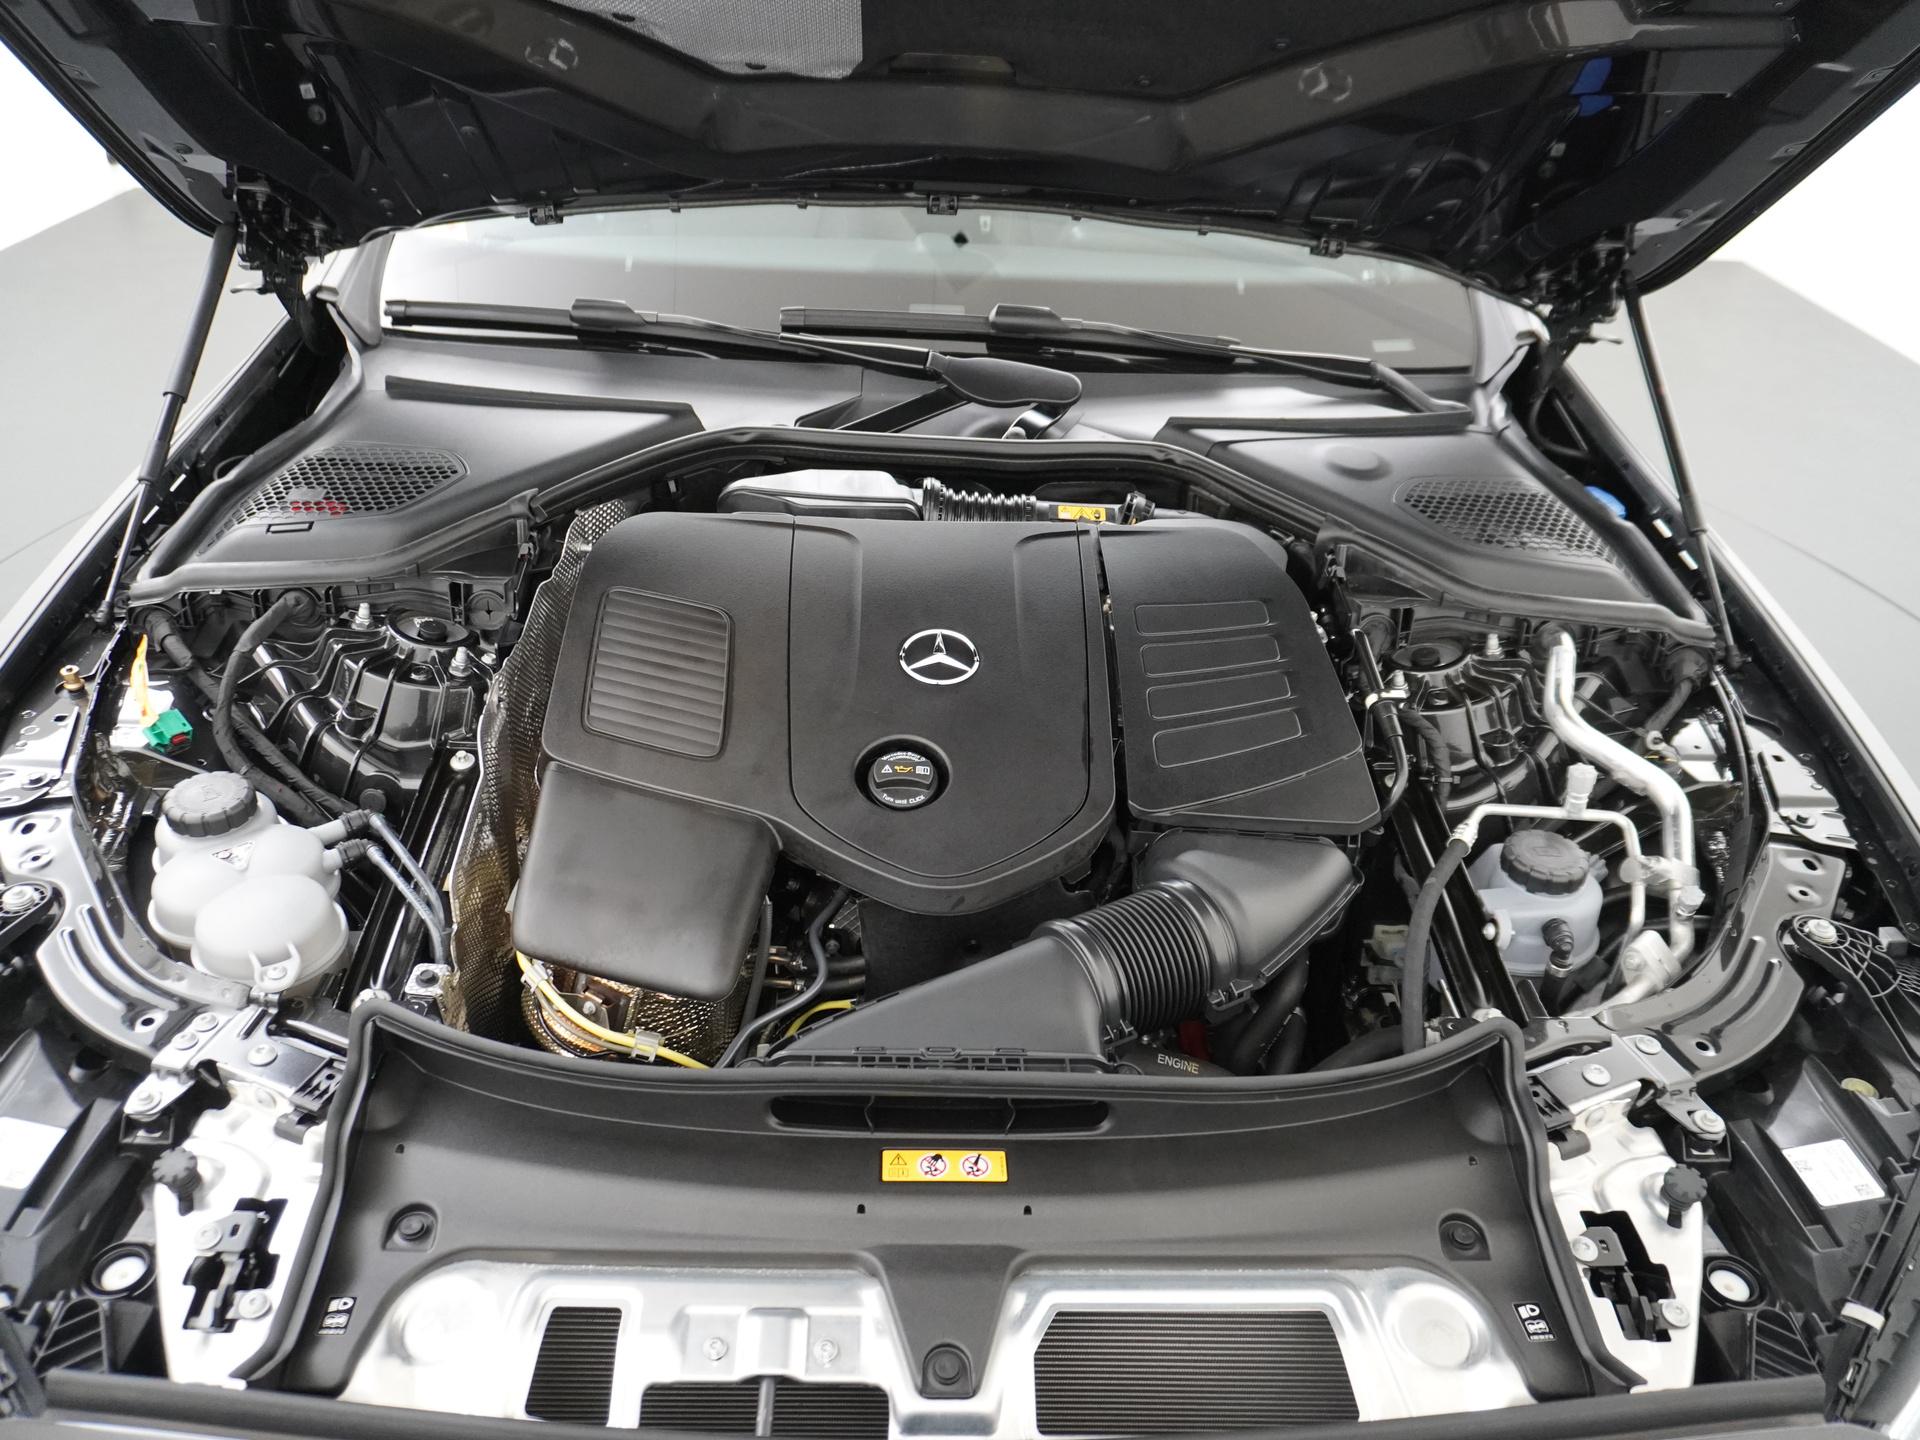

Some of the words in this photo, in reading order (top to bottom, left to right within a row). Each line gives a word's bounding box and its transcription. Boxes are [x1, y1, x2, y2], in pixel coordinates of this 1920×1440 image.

[882, 793, 894, 802] Turn
[909, 794, 925, 804] CLICK
[1157, 1053, 1200, 1074] ENGINE
